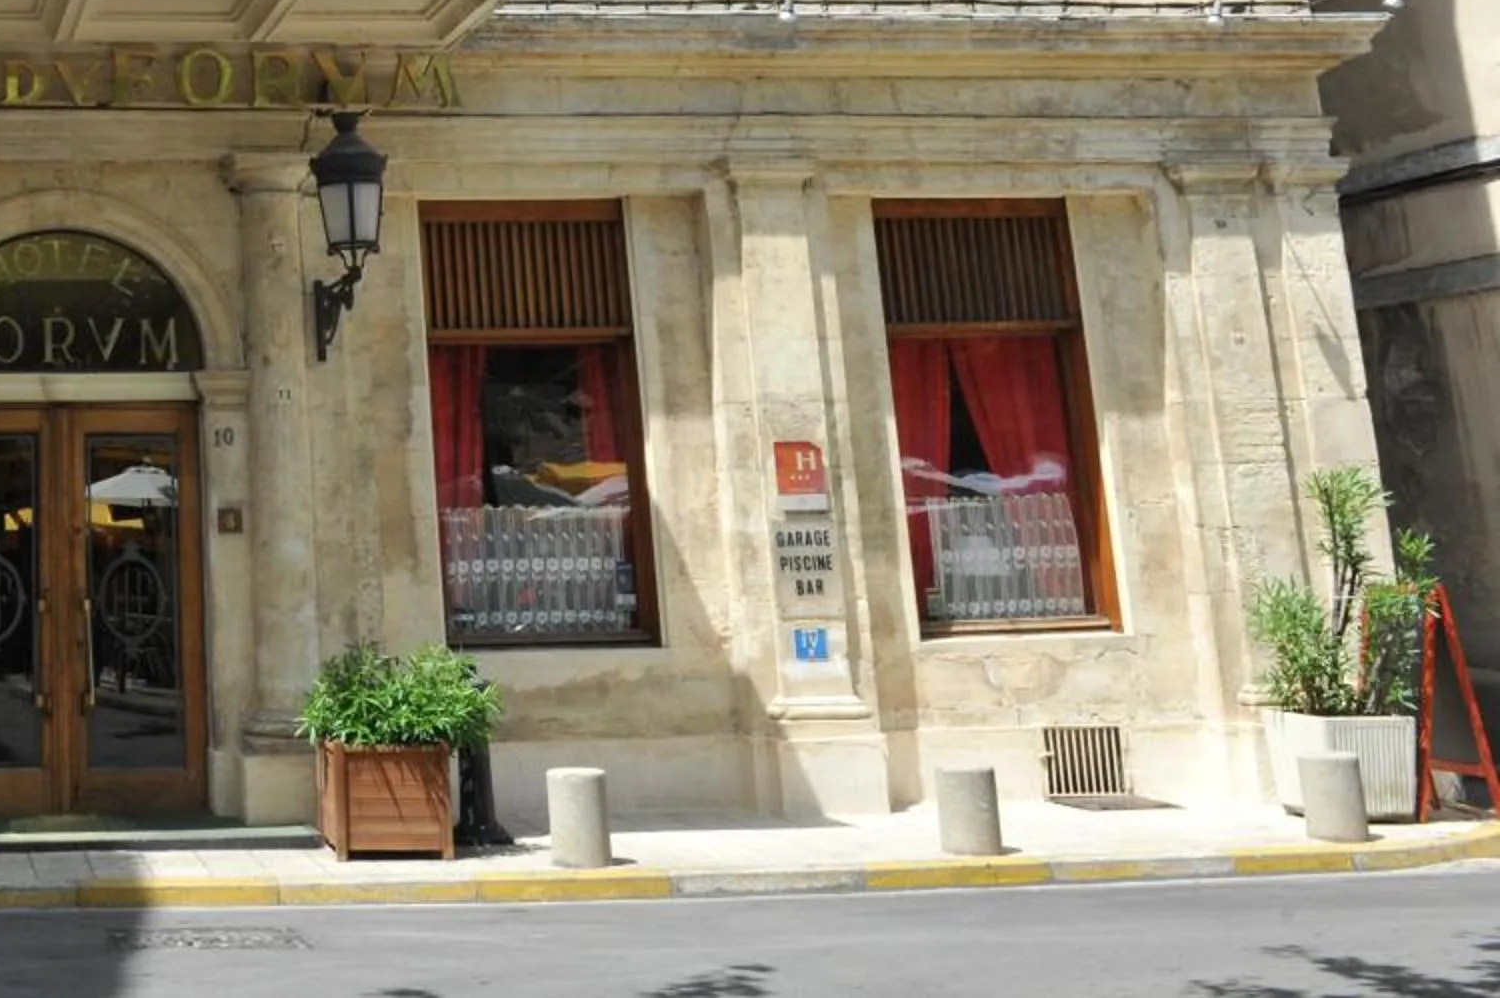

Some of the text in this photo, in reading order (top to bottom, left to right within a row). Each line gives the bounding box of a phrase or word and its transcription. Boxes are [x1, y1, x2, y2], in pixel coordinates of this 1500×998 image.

[108, 47, 464, 109] FORVM
[213, 426, 235, 448] 10
[795, 449, 817, 472] H
[775, 529, 830, 548] GARAGE
[780, 554, 833, 572] PISCINE
[795, 578, 825, 597] BAR
